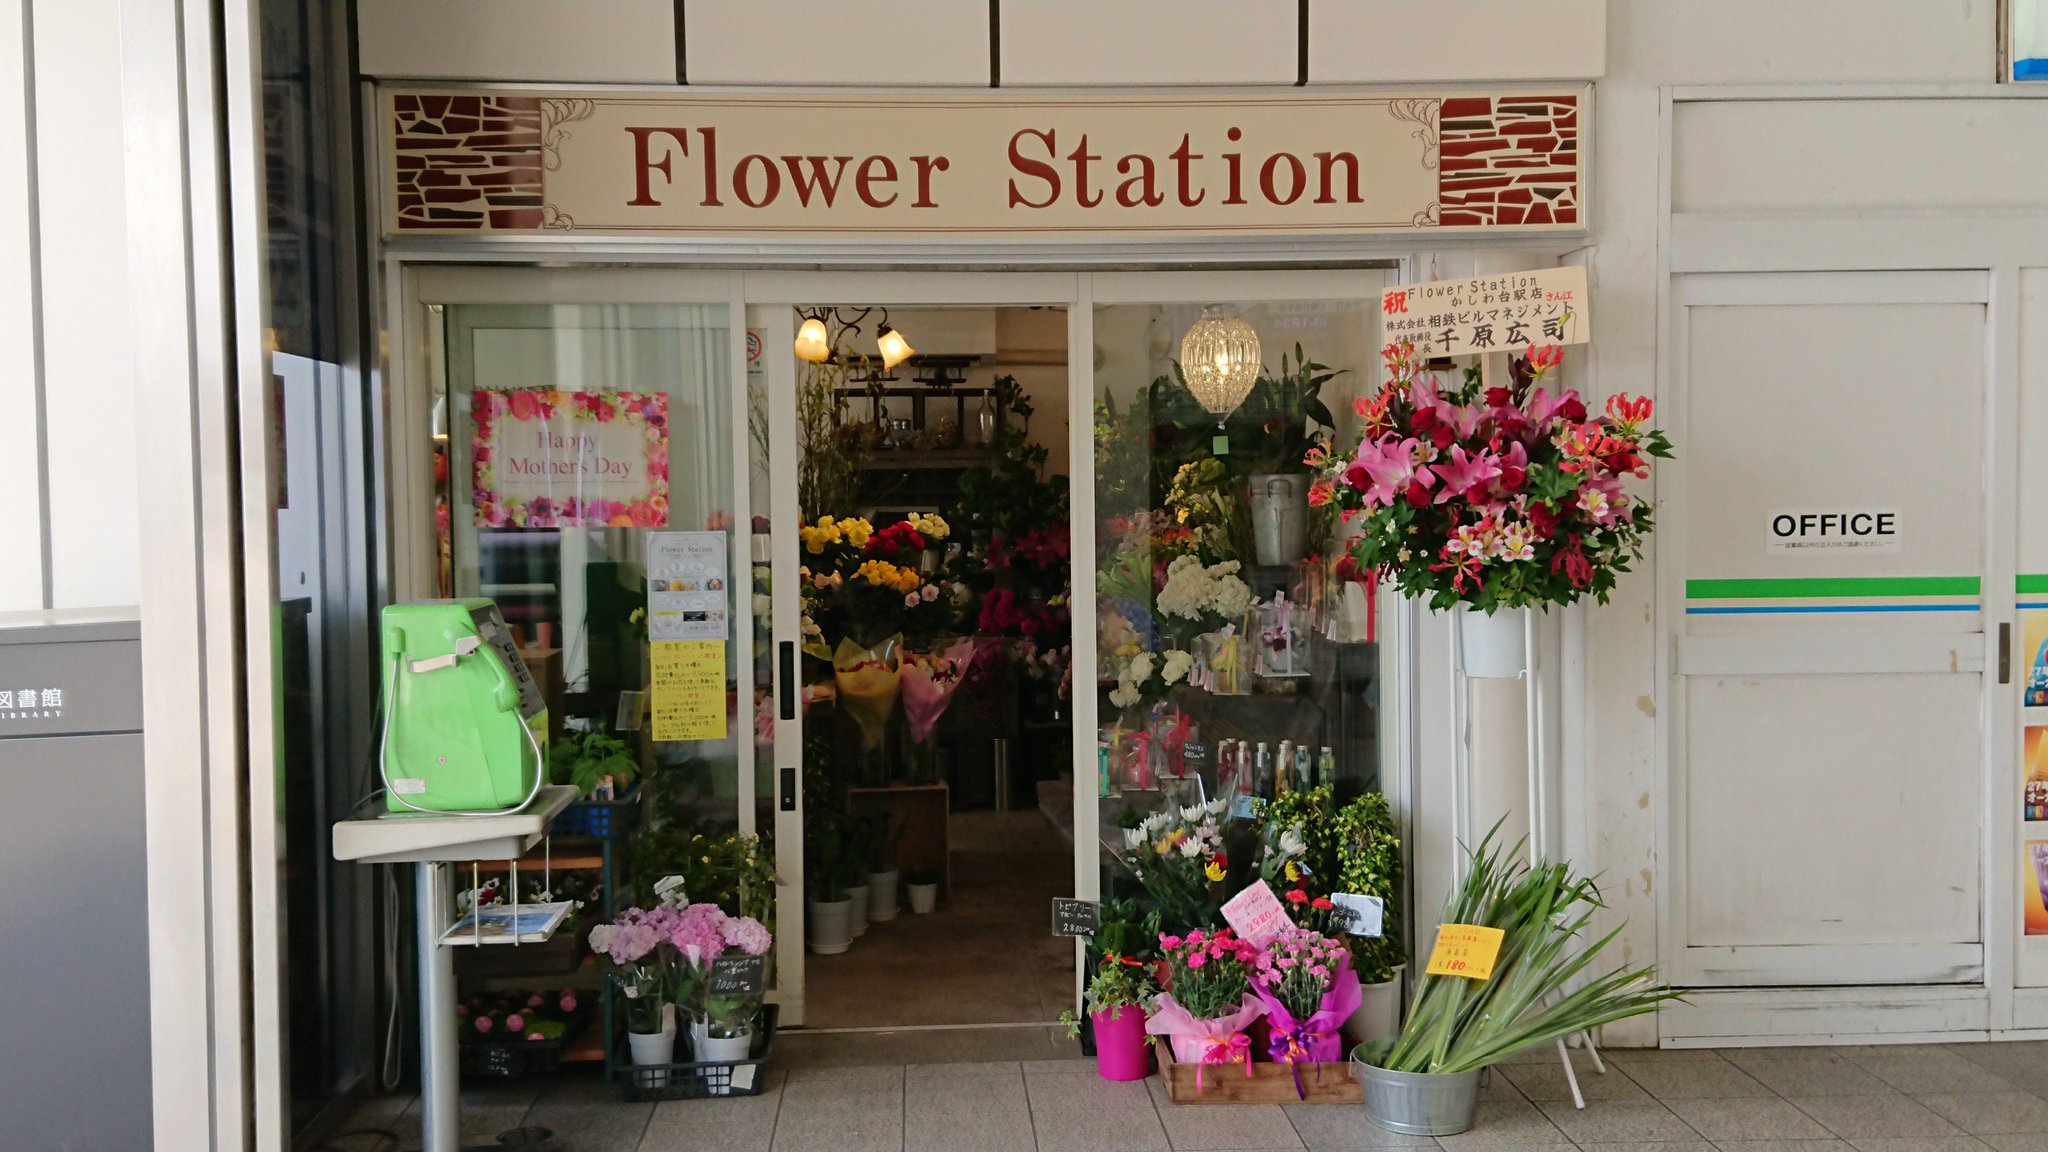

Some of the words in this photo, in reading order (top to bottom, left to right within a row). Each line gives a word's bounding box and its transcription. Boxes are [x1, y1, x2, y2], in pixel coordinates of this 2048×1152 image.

[624, 126, 950, 208] Flower
[1007, 126, 1365, 209] Station
[1408, 285, 1463, 300] Flower
[1470, 277, 1537, 293] Station
[1451, 287, 1543, 307] かしわ台駅店
[1546, 291, 1573, 302] さん江
[1383, 291, 1408, 316] 祝
[1386, 318, 1425, 332] 株式会社
[1429, 301, 1573, 328] 相鉄ビルマネジメント
[1435, 319, 1564, 353] 千原広司
[537, 431, 598, 452] Happy
[595, 457, 633, 479] Day
[1773, 513, 1895, 537] OFFICE
[0, 688, 62, 709] 図書館
